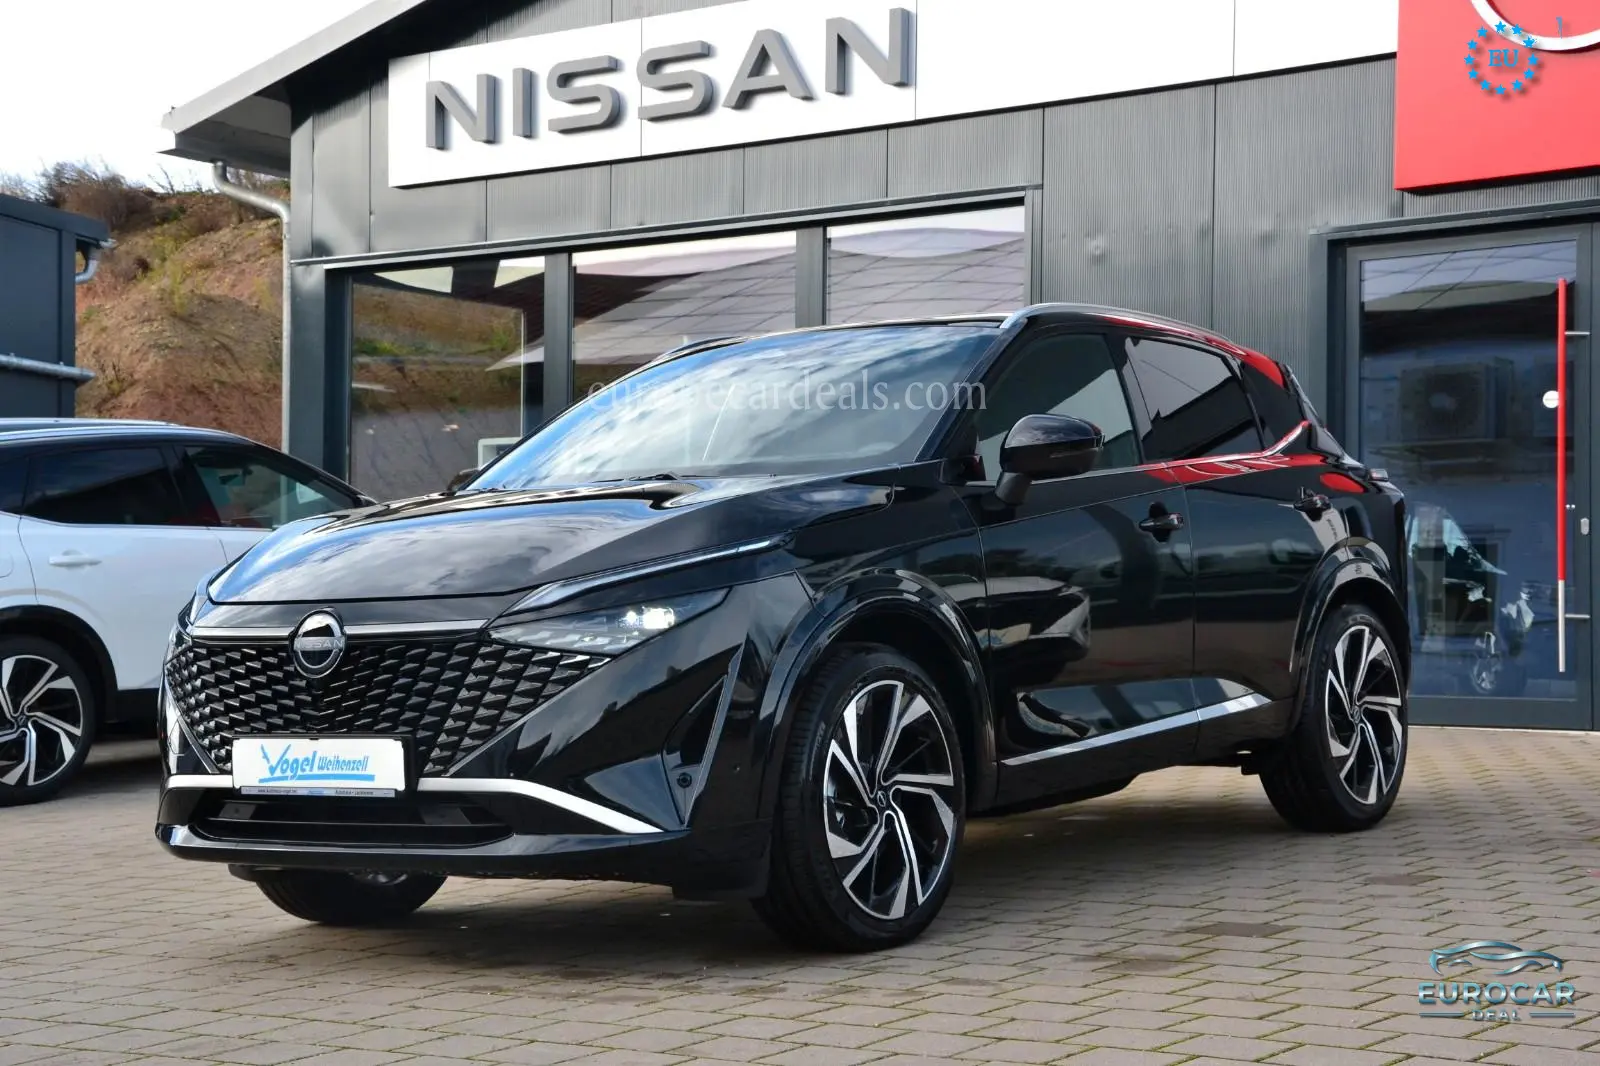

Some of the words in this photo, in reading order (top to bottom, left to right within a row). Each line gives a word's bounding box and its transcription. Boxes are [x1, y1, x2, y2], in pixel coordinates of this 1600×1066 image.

[426, 7, 915, 150] NISSAN
[260, 743, 317, 780] Vogel
[317, 755, 369, 772] Weihenzell
